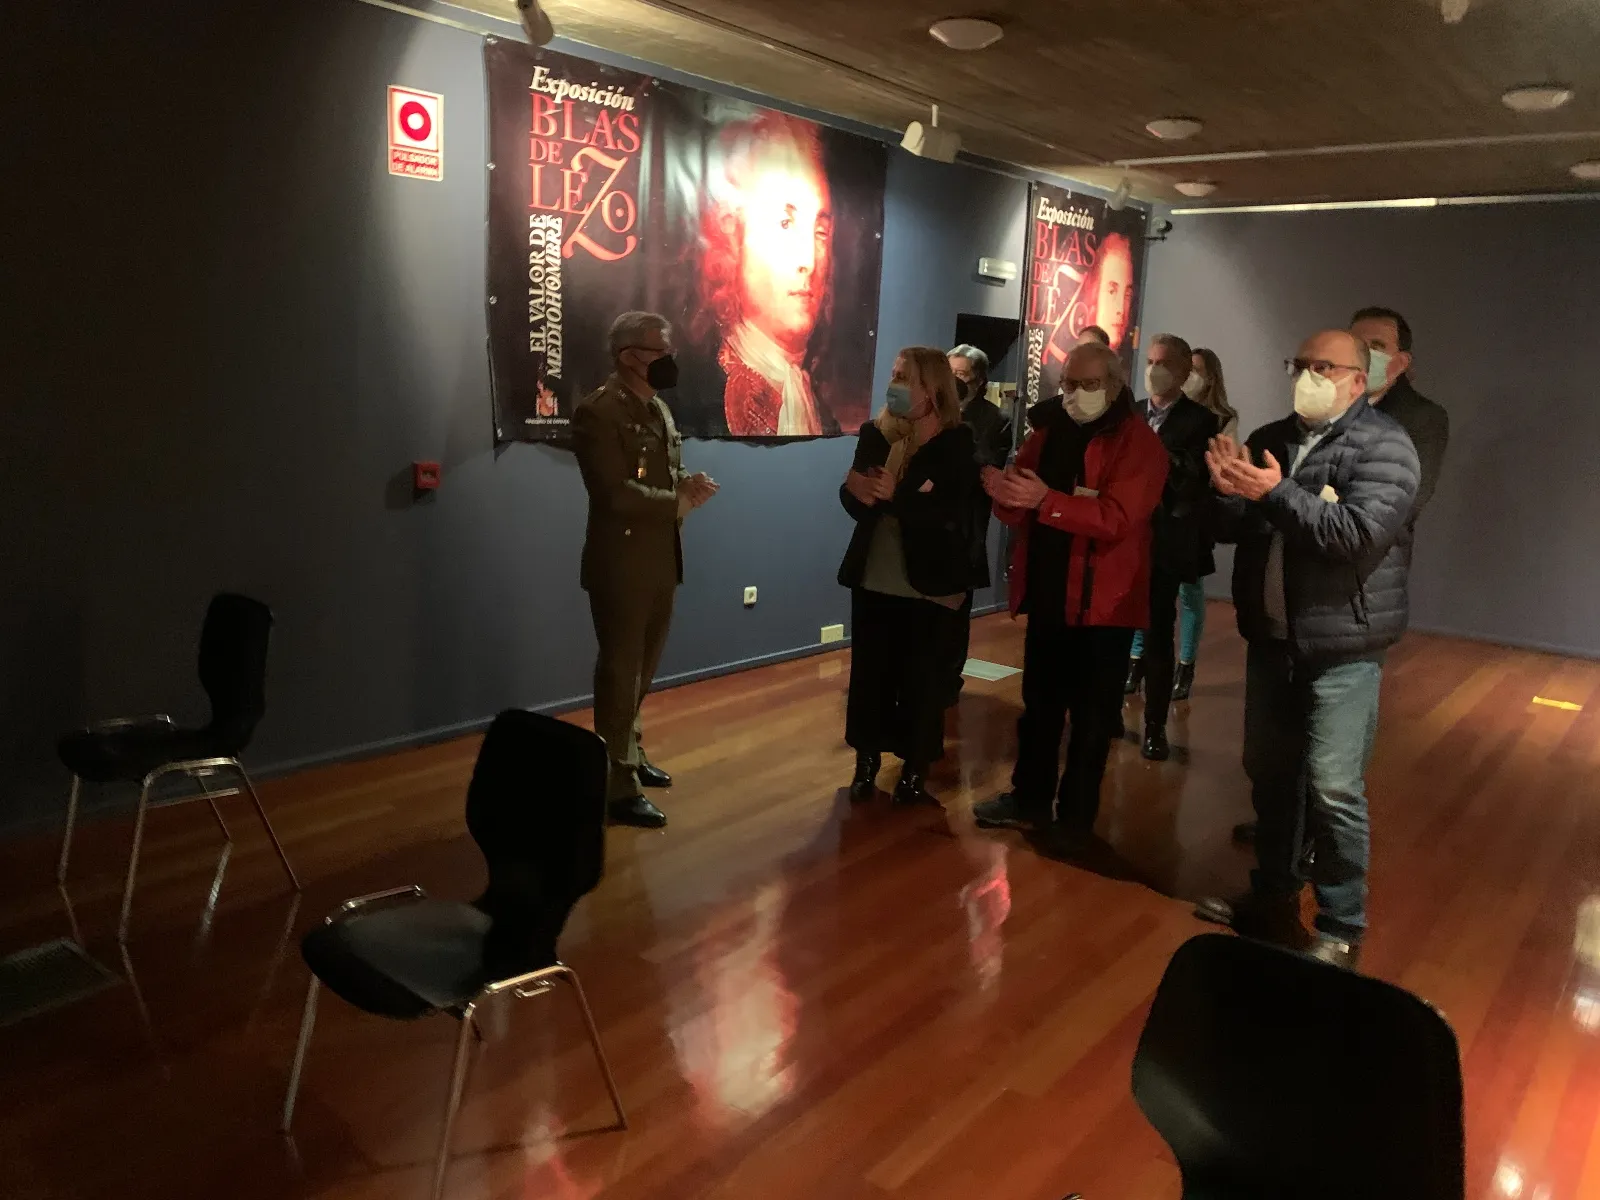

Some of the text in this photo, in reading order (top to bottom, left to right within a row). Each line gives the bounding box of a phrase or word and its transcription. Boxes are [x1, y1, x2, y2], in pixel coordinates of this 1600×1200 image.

[529, 65, 635, 111] Exposición
[529, 92, 640, 153] BLAS
[529, 137, 563, 165] DE
[528, 146, 637, 261] LEZO
[1037, 196, 1095, 231] Exposición
[1035, 220, 1097, 268] BLAS
[529, 213, 546, 353] EL VALOR DE
[1033, 261, 1050, 283] DE
[545, 214, 563, 379] MEDIOHOMBRE
[1028, 329, 1036, 360] DE
